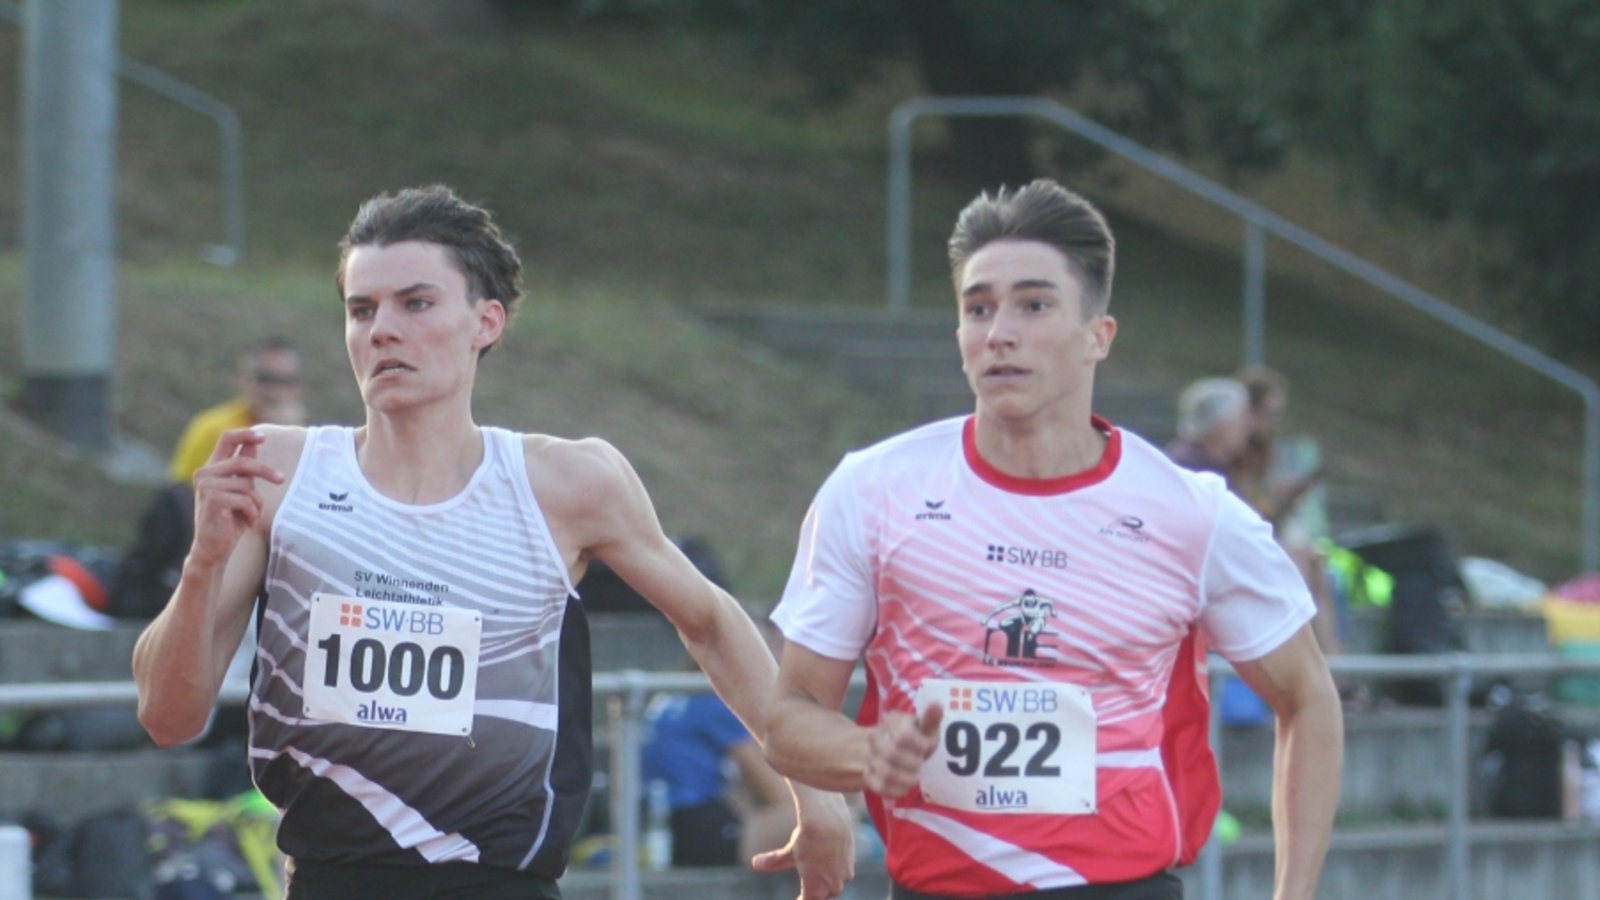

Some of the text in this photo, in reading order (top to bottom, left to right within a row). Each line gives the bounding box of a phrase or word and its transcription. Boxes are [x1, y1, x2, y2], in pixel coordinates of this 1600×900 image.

[354, 570, 450, 593] SV Winnenden
[318, 633, 465, 700] 1000
[356, 699, 409, 724] alwa
[944, 720, 1062, 778] 922
[975, 784, 1029, 808] alwa
